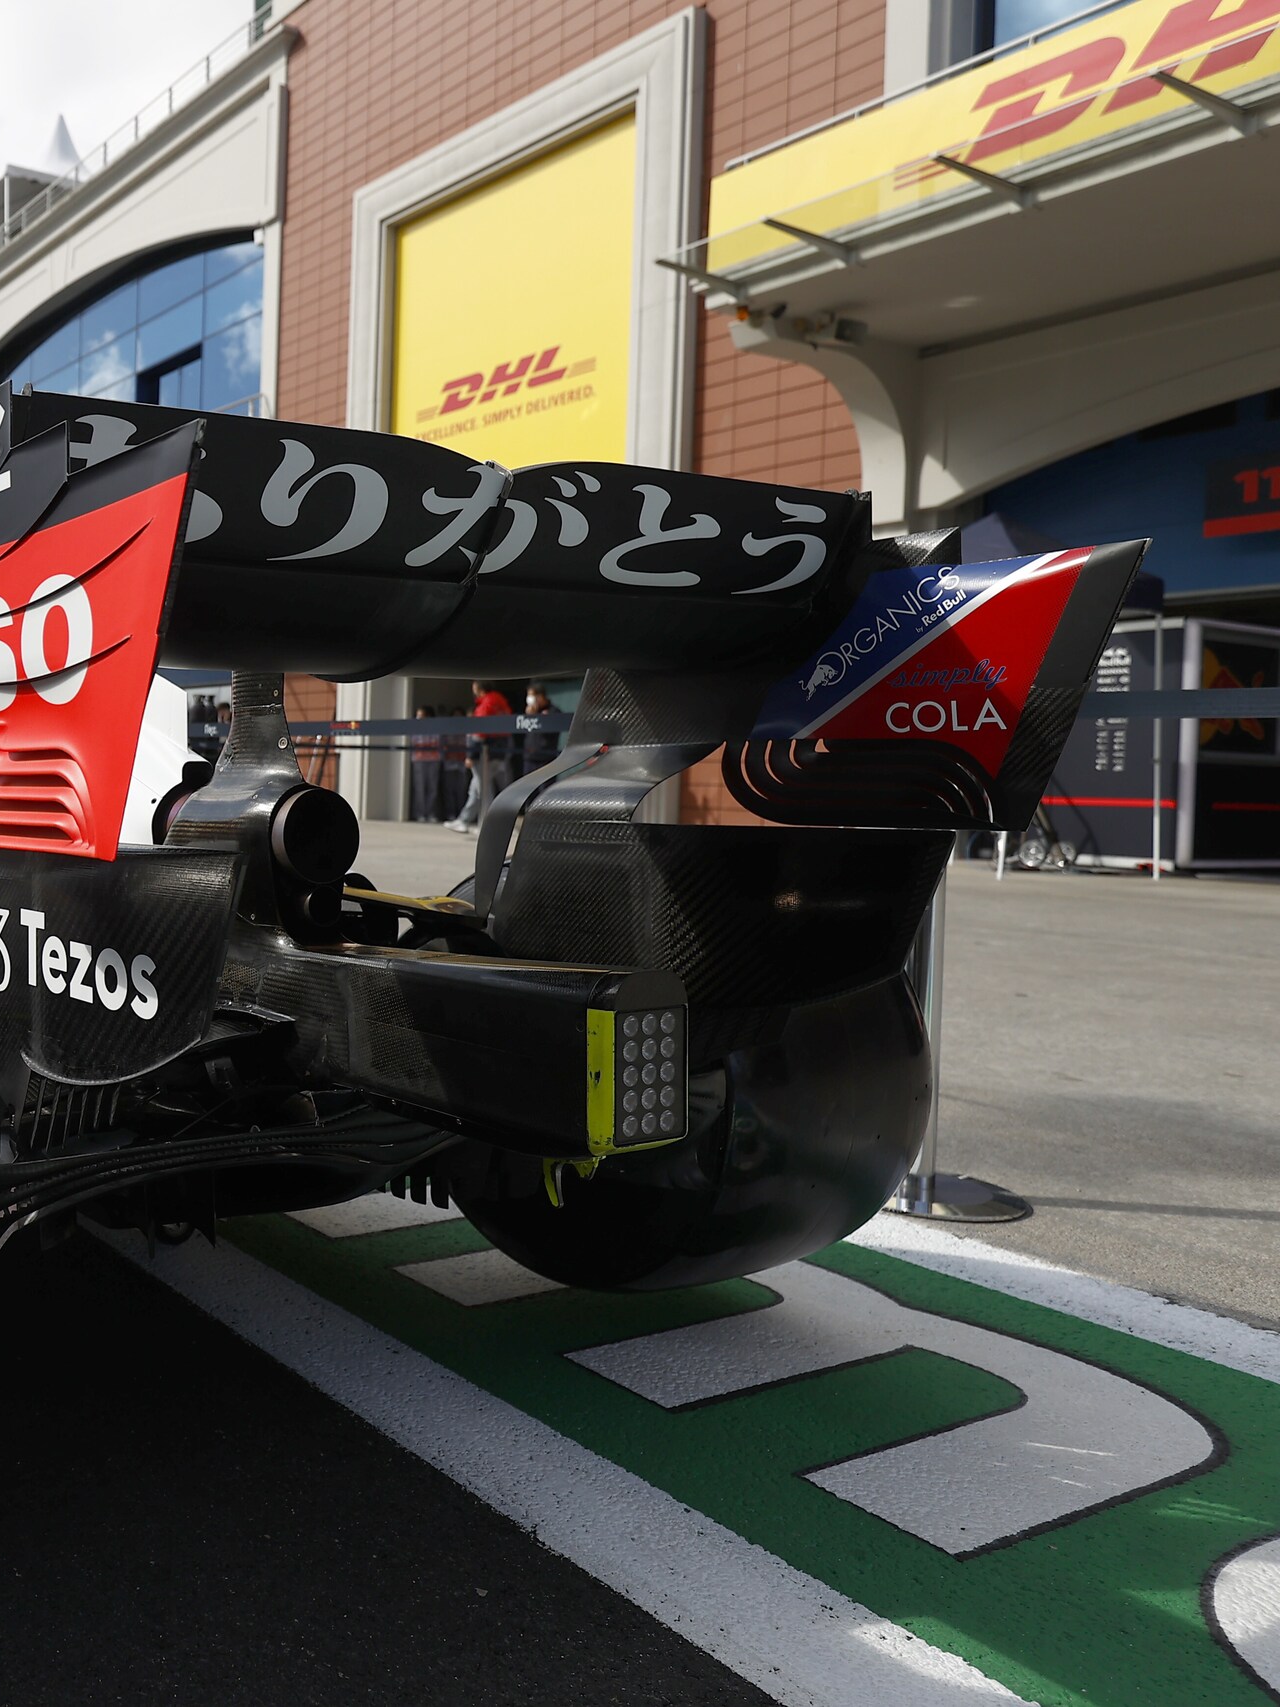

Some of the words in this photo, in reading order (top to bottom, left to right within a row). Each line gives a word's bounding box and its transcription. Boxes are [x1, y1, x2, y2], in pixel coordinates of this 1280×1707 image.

[439, 345, 568, 416] DHL
[482, 406, 523, 427] SIMPLY
[817, 566, 960, 686] ORGANICS
[921, 604, 945, 627] Red
[942, 588, 967, 611] Bull
[887, 658, 1008, 692] simply
[885, 697, 1007, 733] COLA
[20, 907, 159, 1020] Tezos
